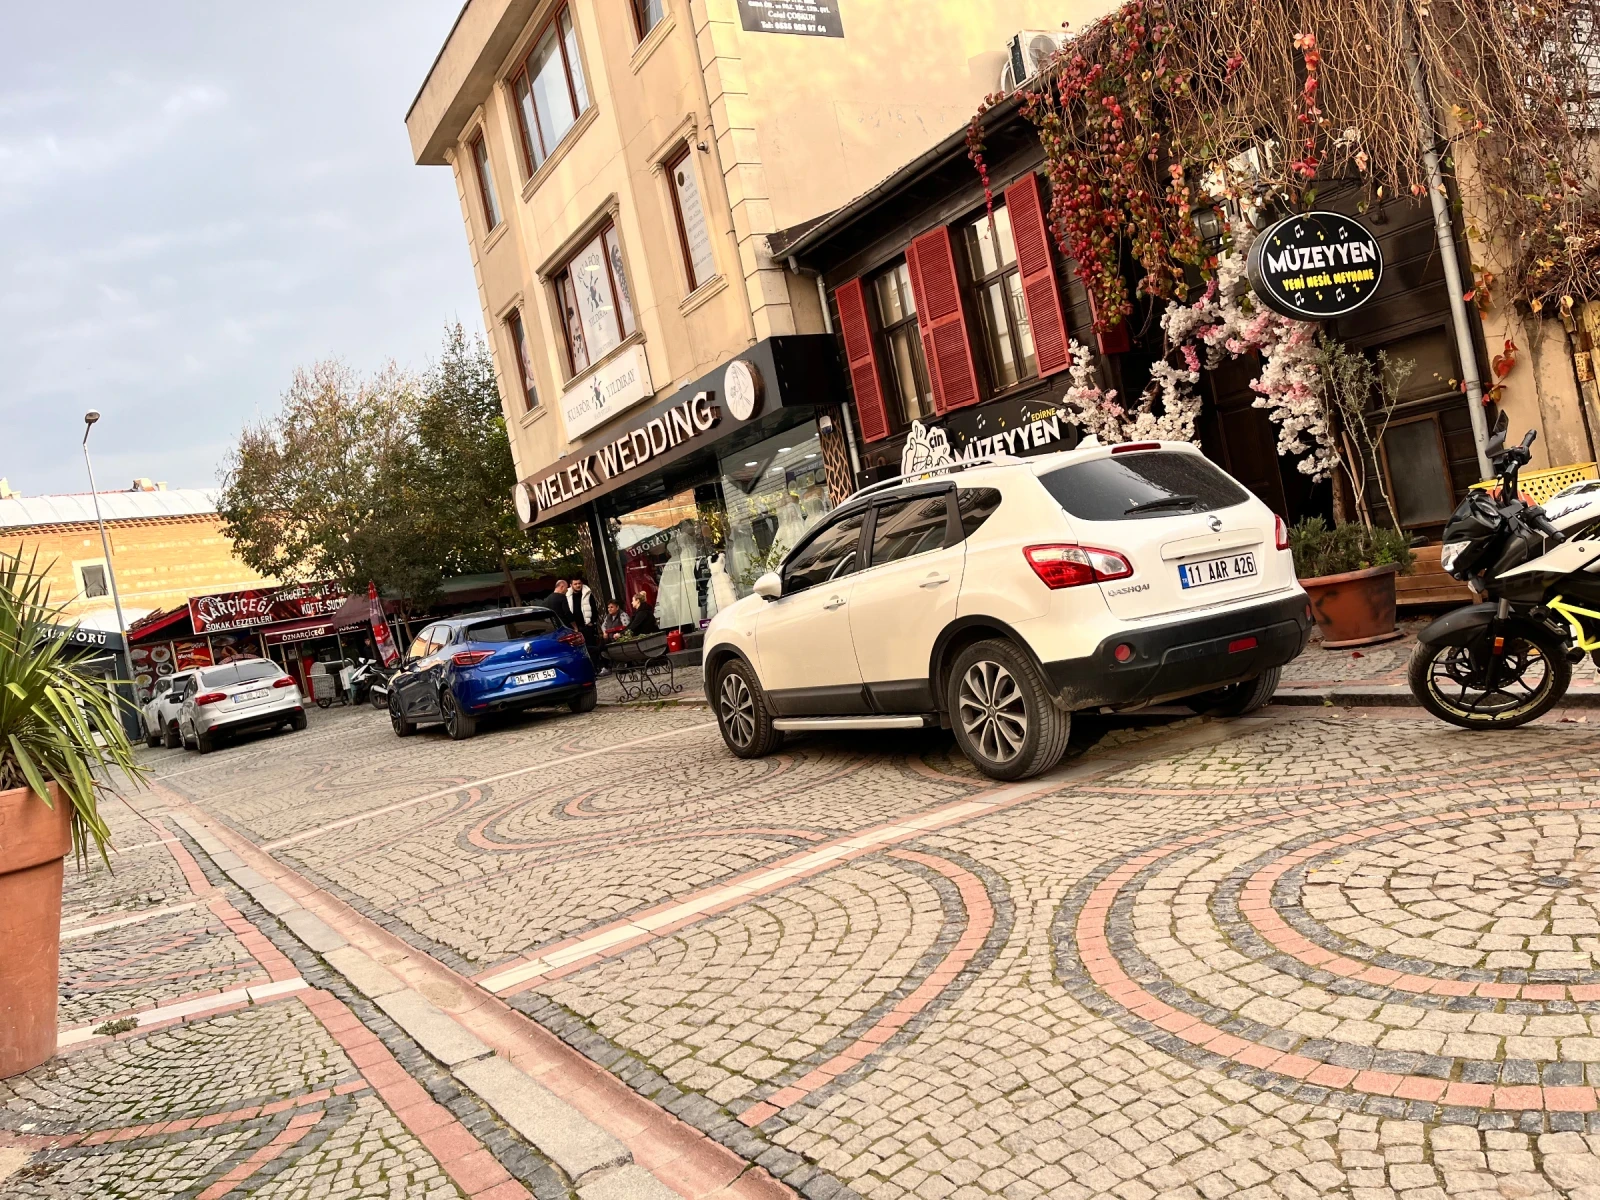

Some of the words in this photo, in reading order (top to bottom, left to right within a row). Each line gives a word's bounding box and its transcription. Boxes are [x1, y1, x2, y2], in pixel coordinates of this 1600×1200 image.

[1267, 240, 1377, 274] MÜZEYYEN
[1282, 274, 1305, 291] YENİ
[1306, 271, 1332, 288] NESİL
[1333, 268, 1375, 284] MEYHANE
[567, 399, 592, 422] KUAFÖR
[1031, 407, 1057, 422] EDİRNE
[533, 455, 598, 511] MELEK
[596, 391, 716, 479] WEDDING
[953, 416, 1061, 468] MÜZEYYEN
[1188, 566, 1203, 584] 11
[1208, 562, 1229, 580] AAR
[1234, 556, 1255, 575] 426
[1108, 583, 1150, 597] QASHQAI
[206, 621, 231, 631] SOKAK
[232, 613, 273, 628] LEZZETLERİ
[515, 674, 525, 684] 34
